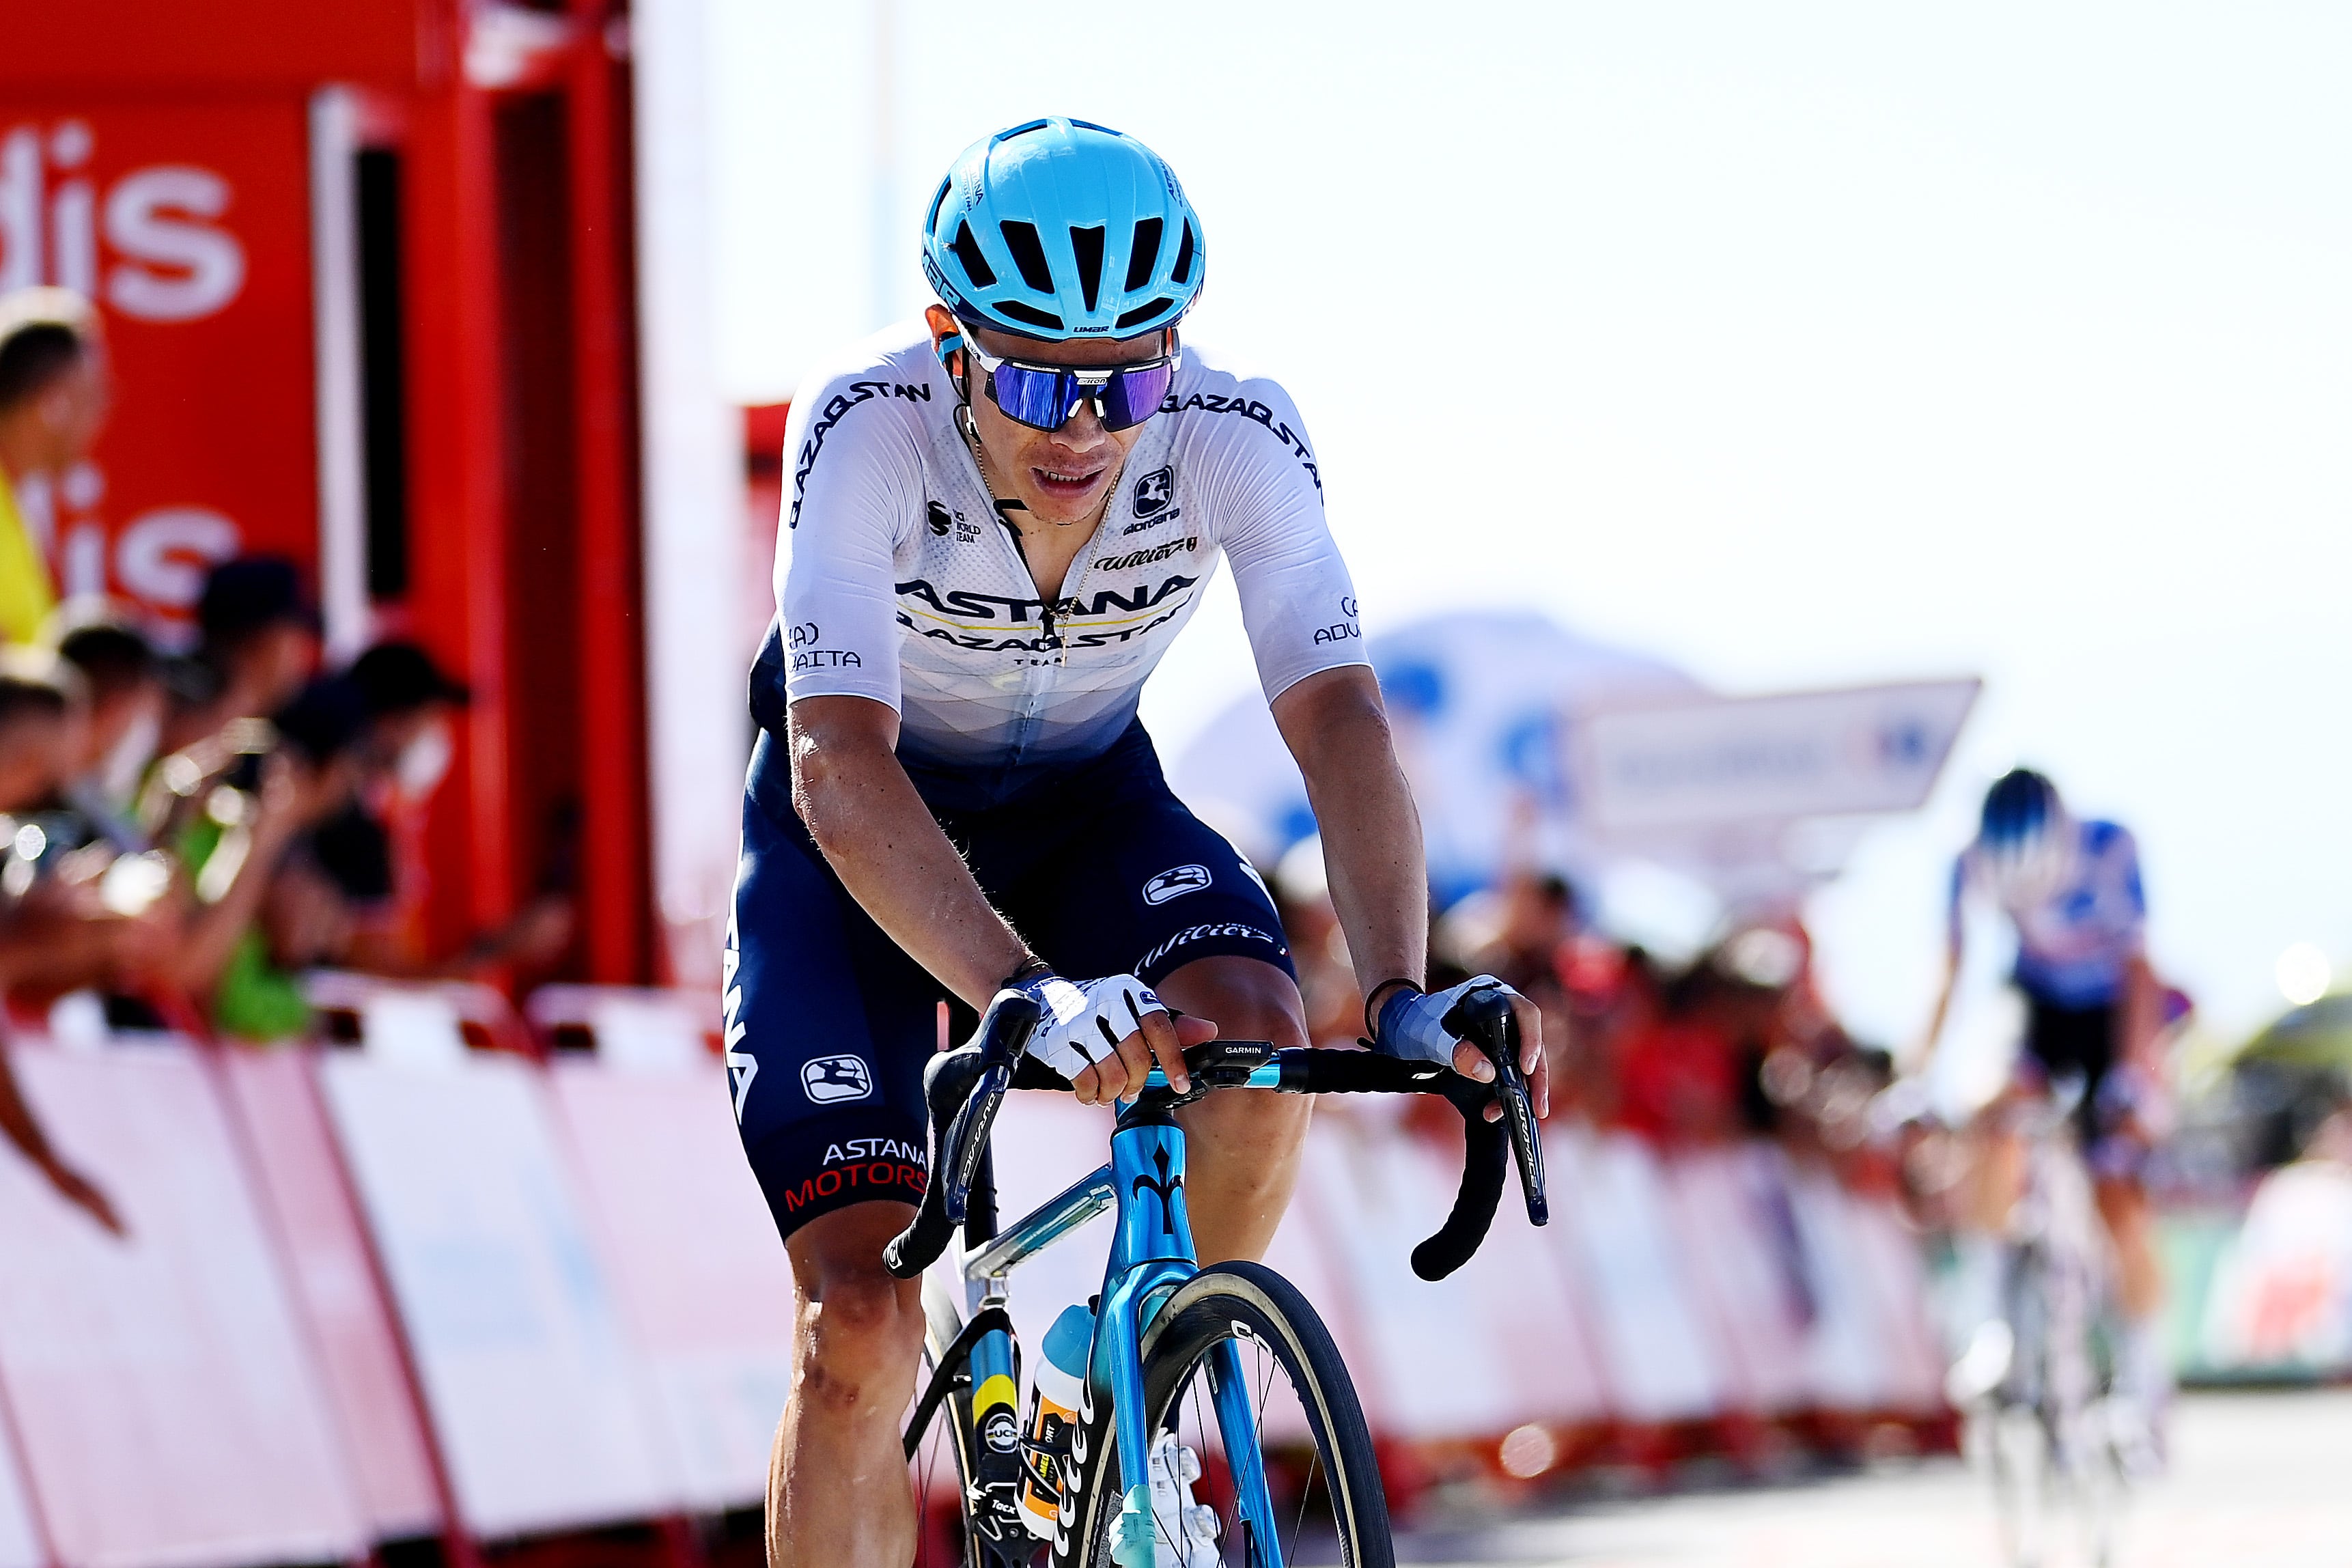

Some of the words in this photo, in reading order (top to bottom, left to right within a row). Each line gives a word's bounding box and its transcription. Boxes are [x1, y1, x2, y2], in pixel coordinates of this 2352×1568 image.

[1158, 393, 1324, 507] QAZAQSTA
[895, 575, 1201, 622] ASTANA
[1225, 1046, 1262, 1054] GARMIN
[822, 1138, 927, 1171] ASTANA
[785, 1162, 928, 1212] MOTORS
[992, 1499, 1016, 1515] Tacx
